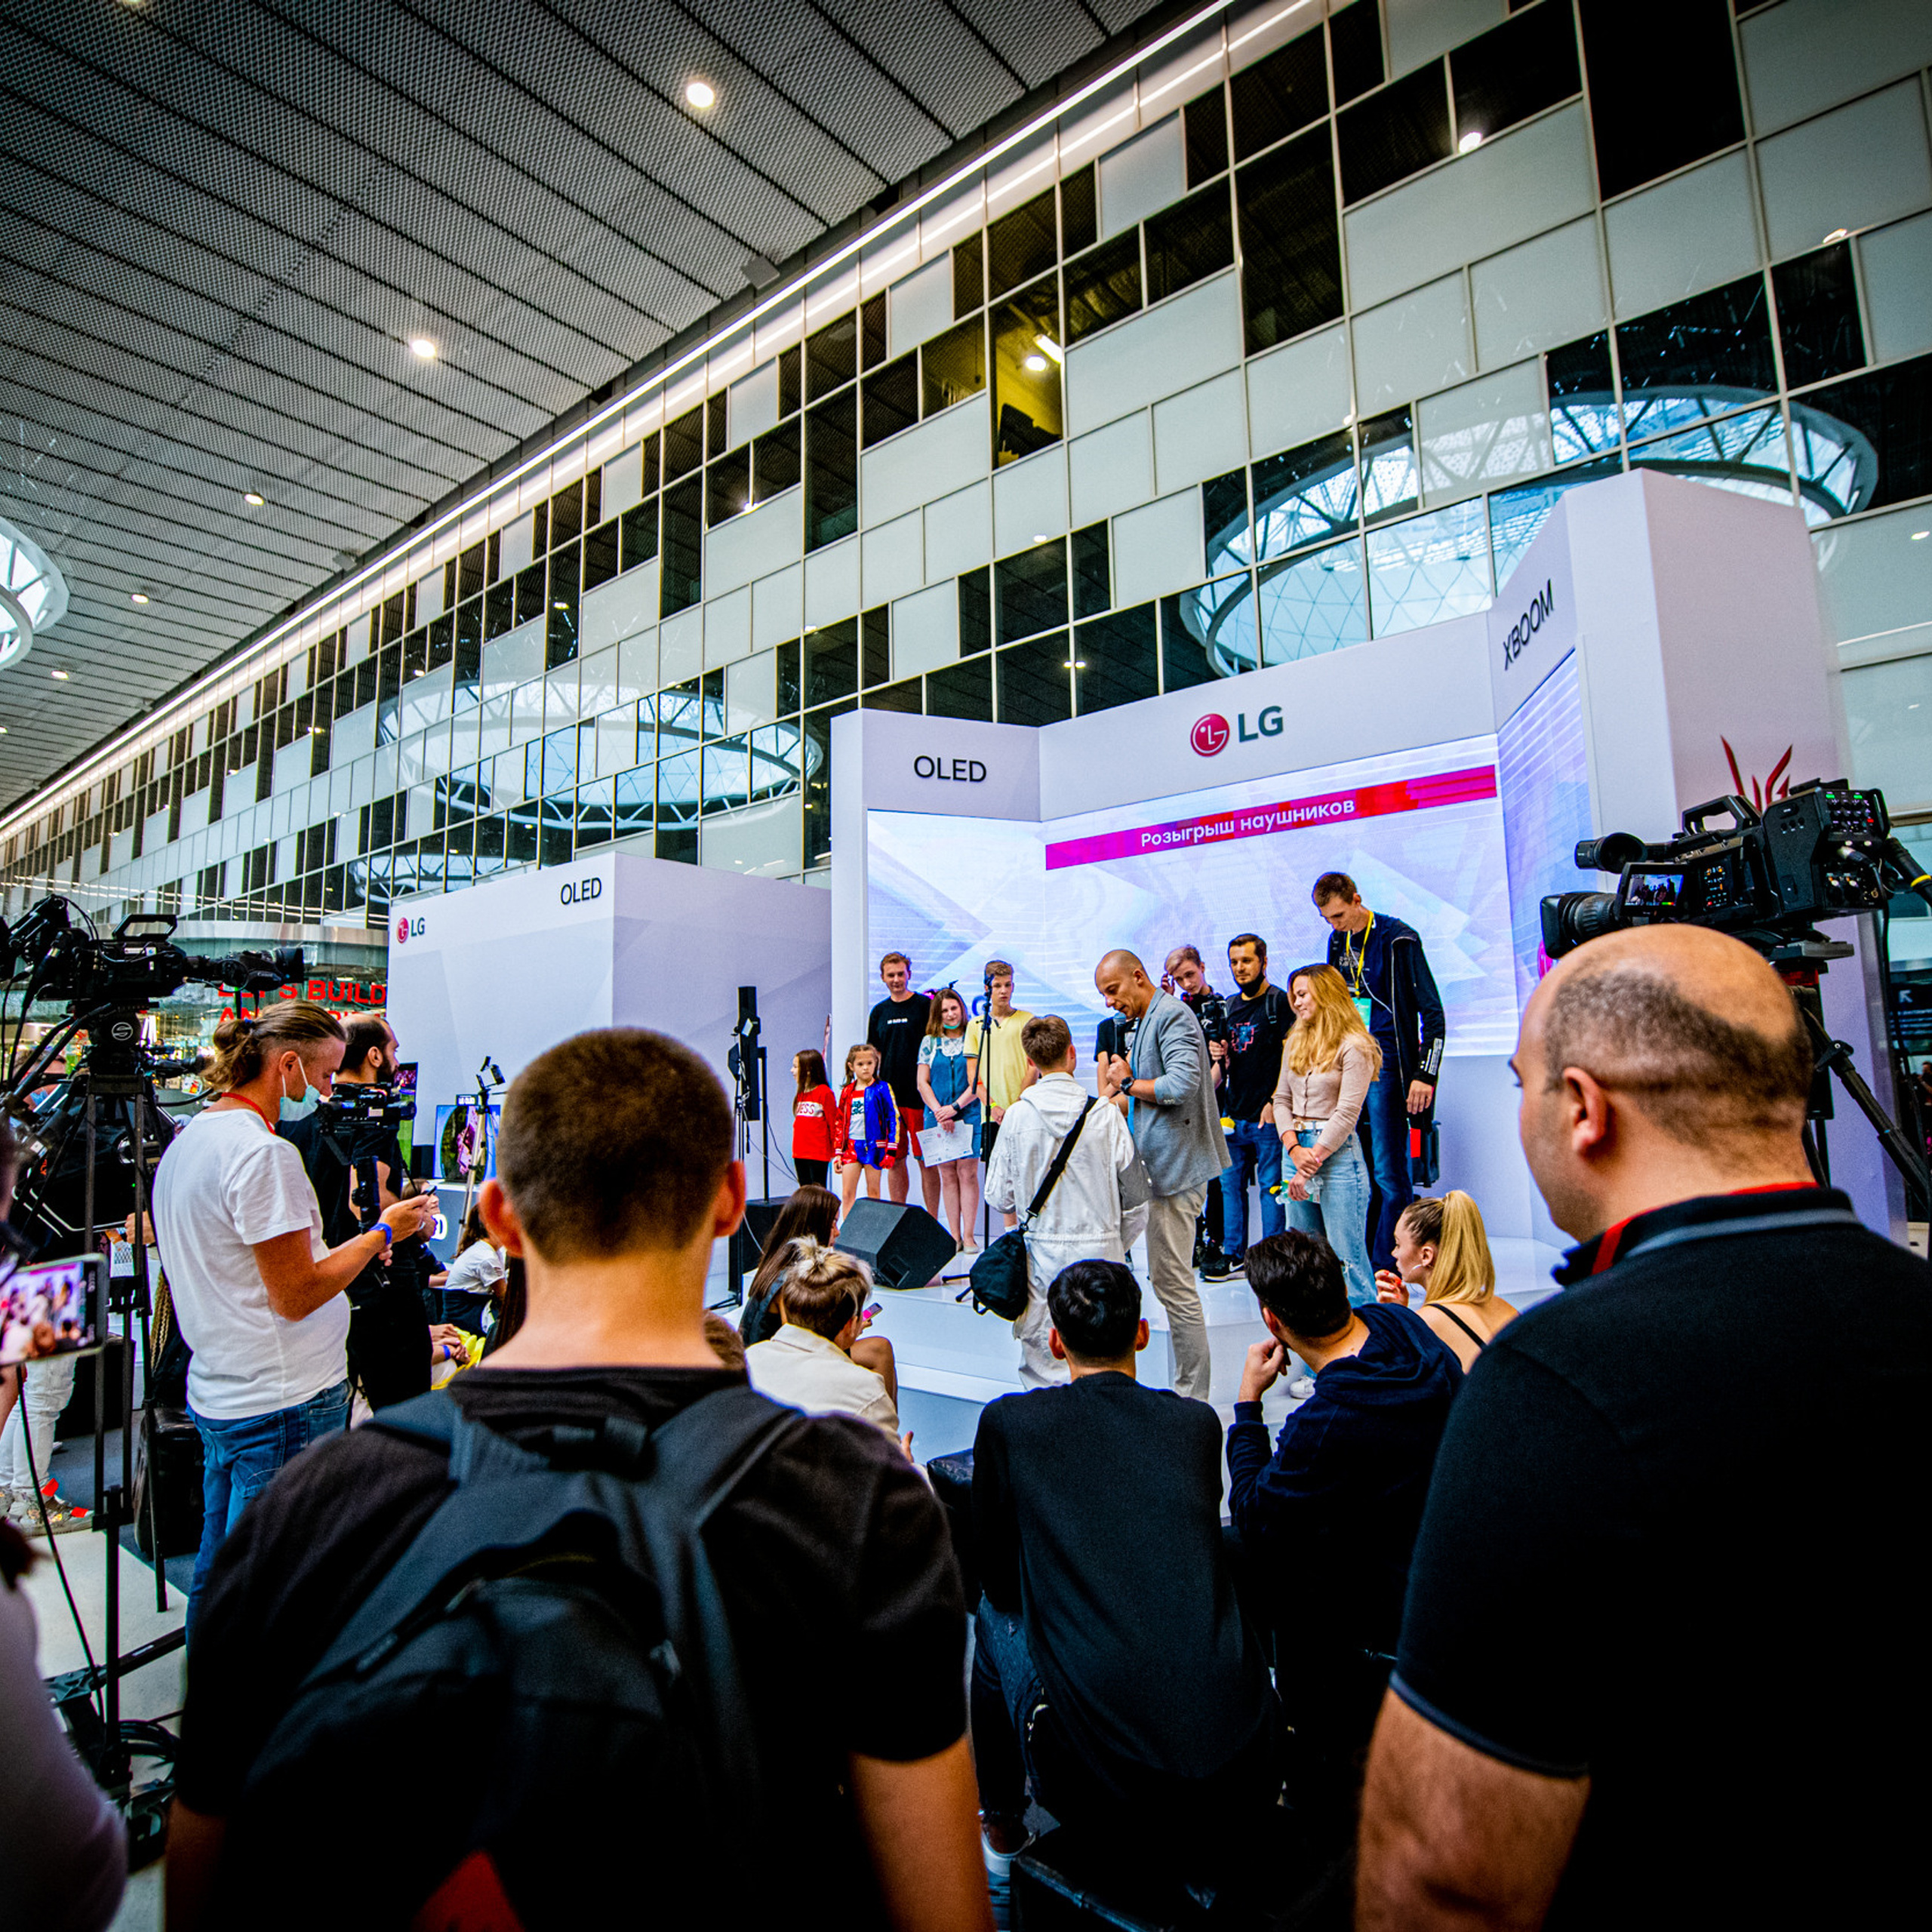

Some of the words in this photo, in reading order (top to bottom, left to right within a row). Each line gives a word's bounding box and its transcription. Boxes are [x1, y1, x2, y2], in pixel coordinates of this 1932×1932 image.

[1503, 578, 1553, 671] XBOOM
[1238, 706, 1284, 743] LG
[914, 755, 987, 782] OLED
[1141, 820, 1235, 847] Розыгрыш
[1240, 799, 1355, 831] наушников
[560, 877, 602, 906] OLED
[411, 917, 425, 937] LG
[308, 980, 386, 1004] BUILD
